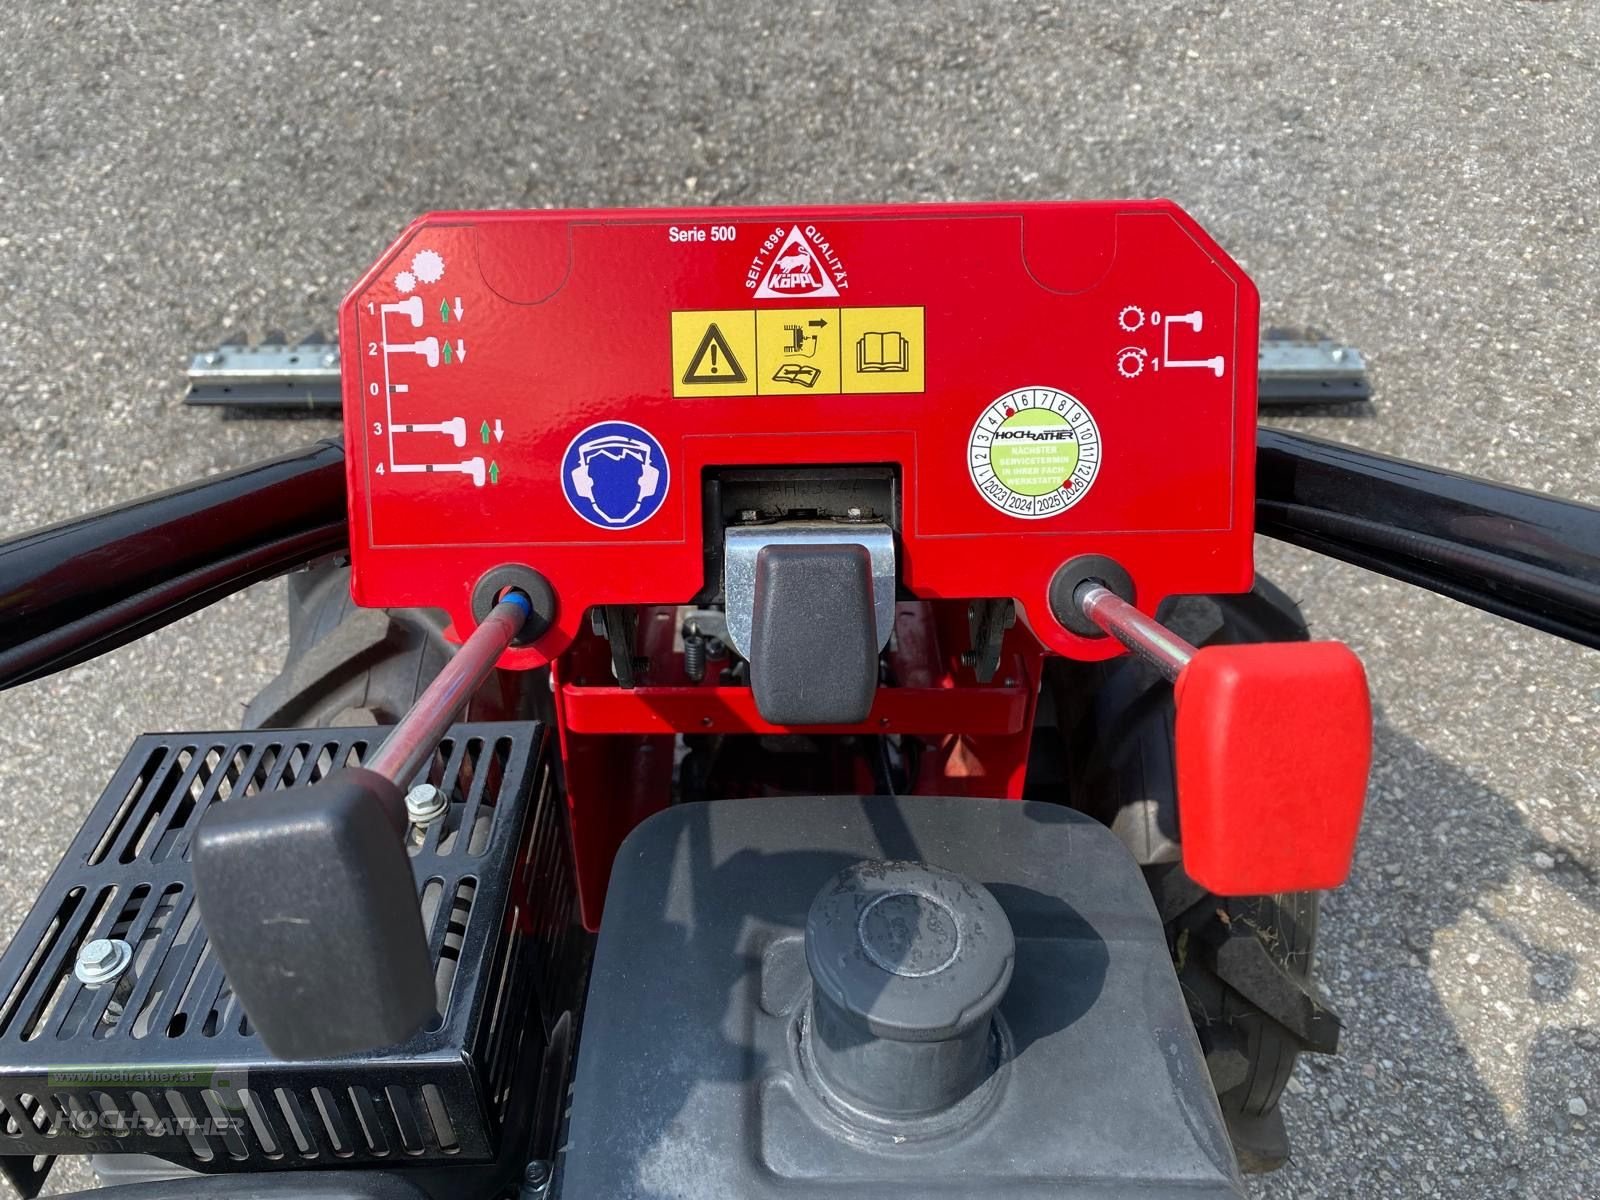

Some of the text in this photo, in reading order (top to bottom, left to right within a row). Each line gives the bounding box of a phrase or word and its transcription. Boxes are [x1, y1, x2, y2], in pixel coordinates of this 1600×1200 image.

[669, 226, 737, 242] Serie 500
[745, 227, 785, 289] SEIT 1896
[805, 225, 848, 289] QUALITÄT
[368, 302, 375, 315] 1
[1151, 311, 1161, 325] 0
[368, 342, 377, 356] 2
[1151, 357, 1159, 371] 1
[370, 383, 379, 395] 0
[1022, 394, 1029, 406] 6
[1042, 393, 1048, 405] 7
[1058, 400, 1067, 411] 8
[1002, 401, 1010, 411] 5
[988, 416, 998, 426] 4
[1072, 412, 1082, 423] 9
[373, 422, 382, 435] 3
[1080, 428, 1093, 440] 10
[977, 434, 989, 442] 3
[995, 430, 1074, 441] HOCHRATHER
[1082, 446, 1094, 457] 11
[375, 462, 385, 475] 4
[1078, 464, 1092, 476] 12
[985, 480, 1007, 500] 2023
[1061, 478, 1084, 500] 2026
[1008, 496, 1032, 512] 2024
[1037, 495, 1061, 512] 2025
